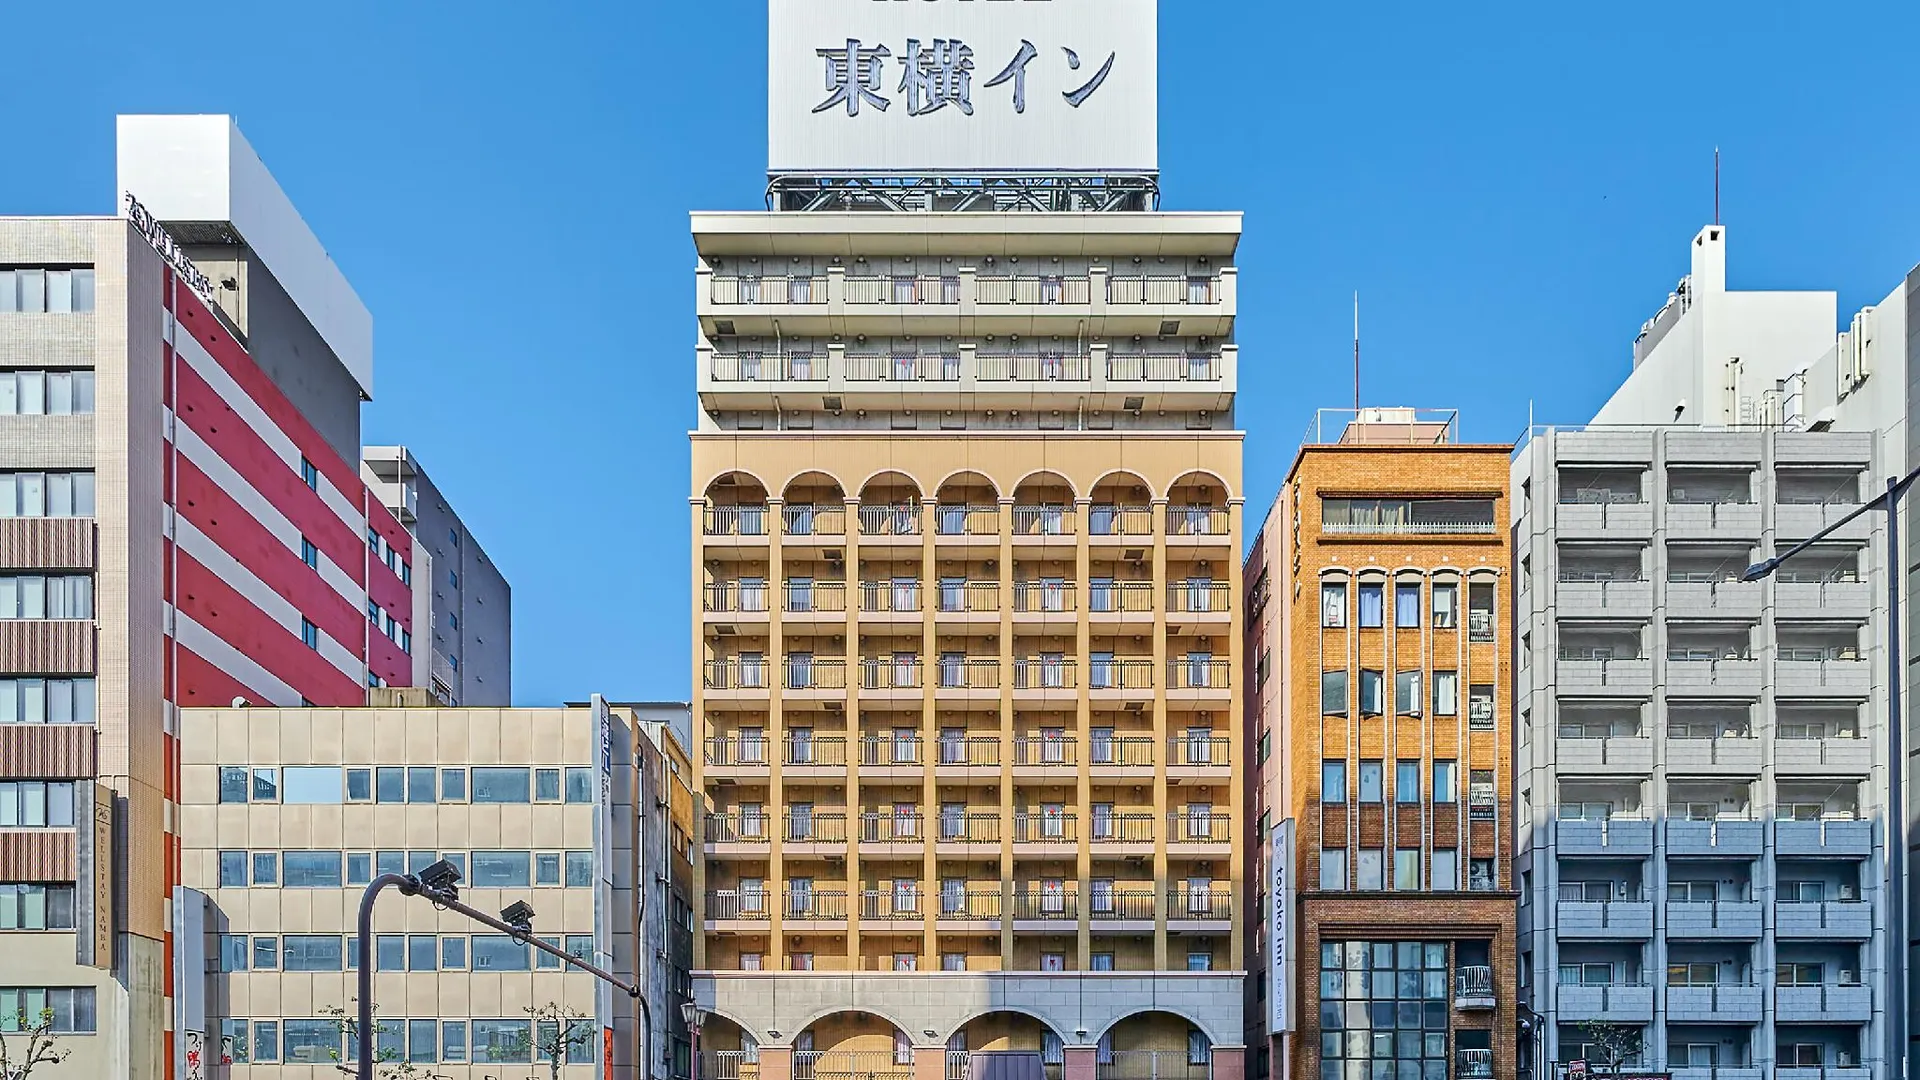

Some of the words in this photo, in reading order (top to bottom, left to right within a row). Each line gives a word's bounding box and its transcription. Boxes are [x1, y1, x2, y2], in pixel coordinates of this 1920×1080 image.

[812, 38, 1115, 116] 東横イン
[99, 827, 107, 898] WELLSTAY
[99, 905, 107, 951] NAMBA
[1275, 866, 1284, 932] toyoko
